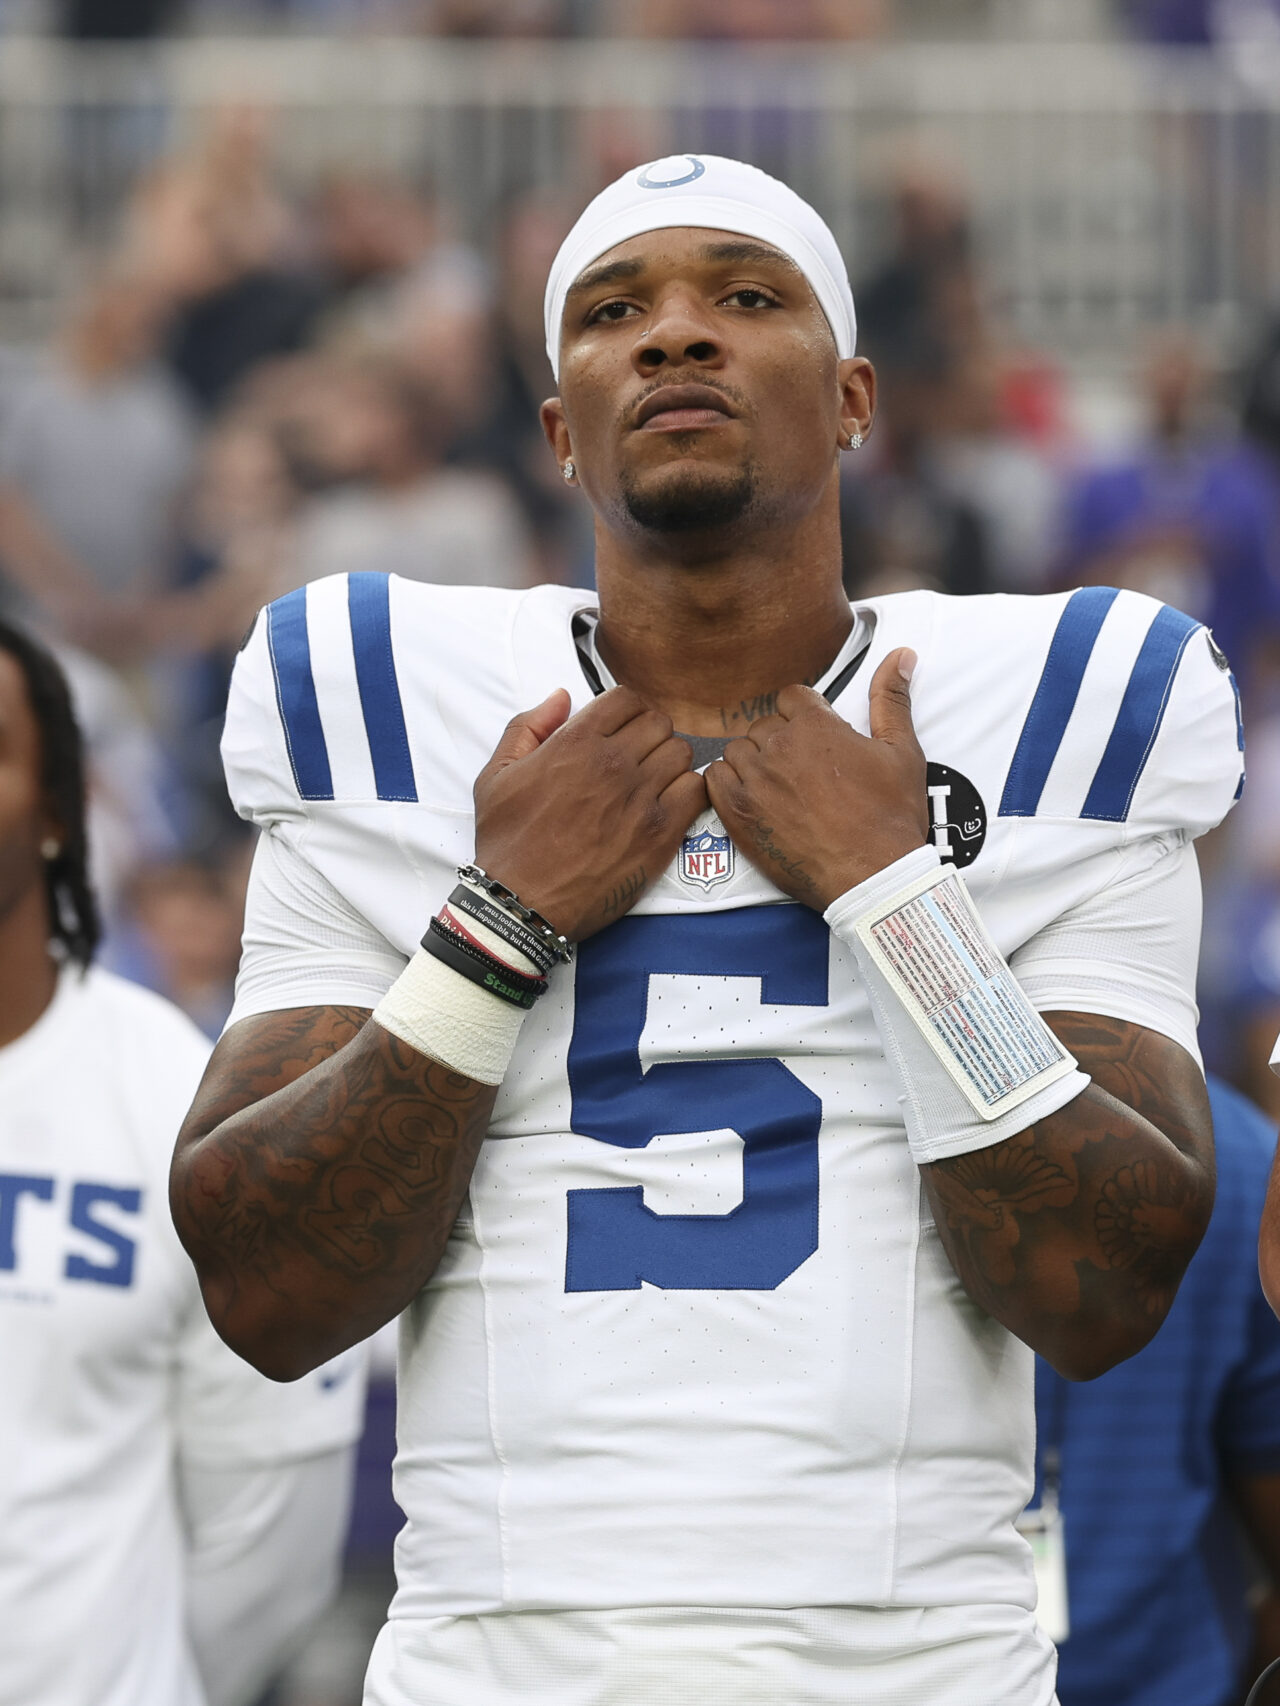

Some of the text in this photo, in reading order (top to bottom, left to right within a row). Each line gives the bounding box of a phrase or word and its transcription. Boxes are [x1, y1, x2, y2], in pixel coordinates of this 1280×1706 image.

[687, 852, 726, 878] NFL
[460, 900, 471, 911] this
[471, 906, 478, 914] is
[477, 910, 509, 938] impossible,
[510, 935, 521, 945] but
[522, 942, 536, 958] with
[498, 914, 521, 934] looked
[519, 929, 527, 938] at
[526, 934, 543, 951] them
[484, 973, 523, 1000] Stand
[566, 905, 831, 1293] 5
